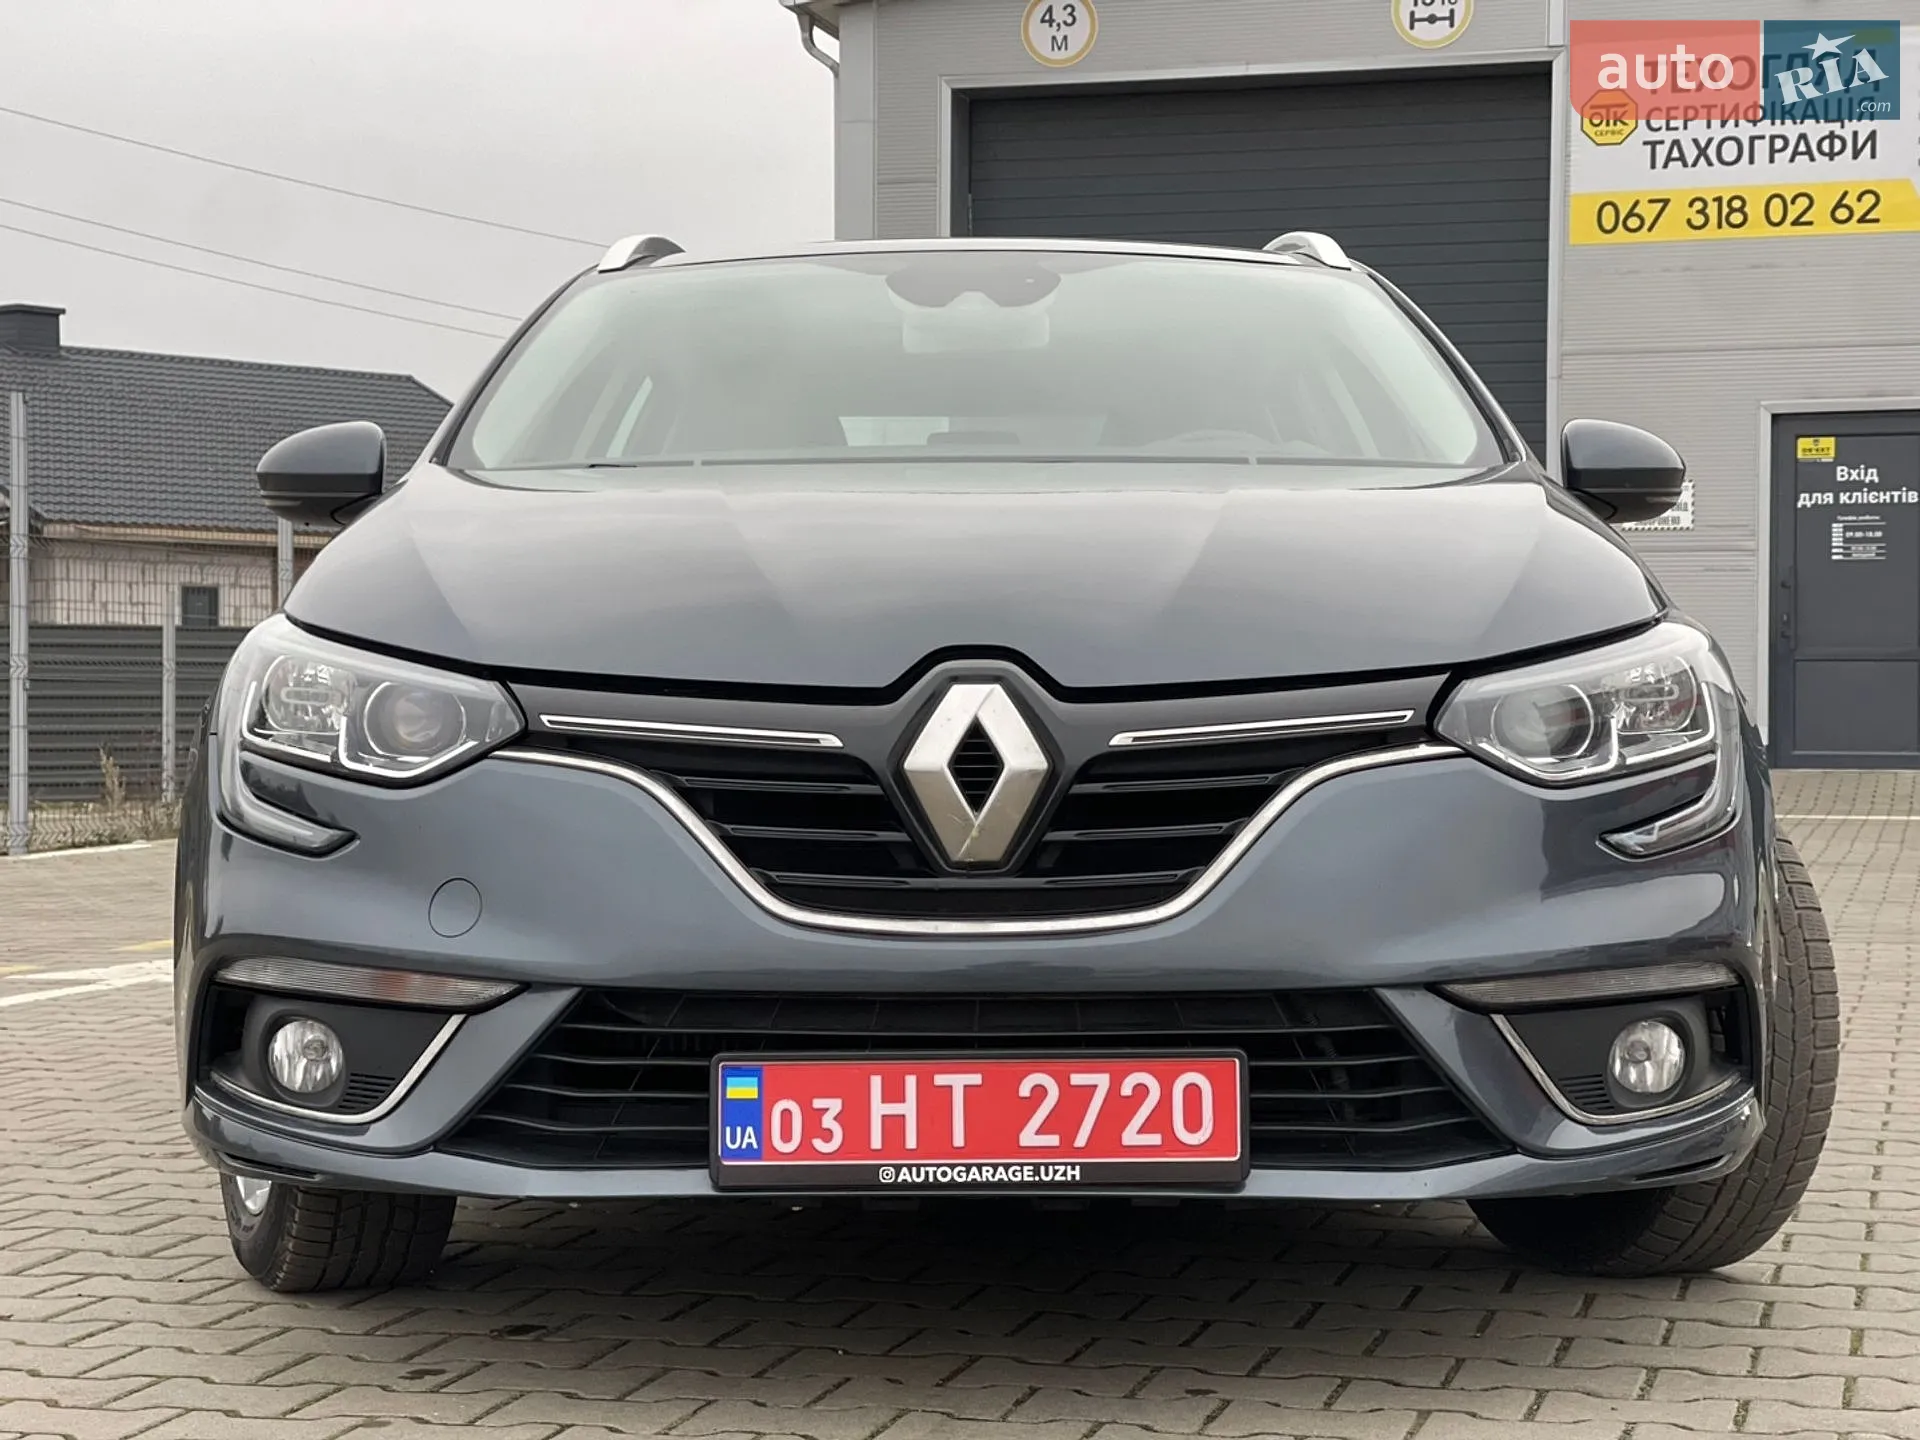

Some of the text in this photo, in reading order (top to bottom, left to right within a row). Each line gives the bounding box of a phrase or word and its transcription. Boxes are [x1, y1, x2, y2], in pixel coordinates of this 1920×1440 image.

[1040, 3, 1077, 32] 4,3
[1645, 96, 1875, 132] СЕРТИФІКАЦІЯ
[1642, 129, 1878, 170] ТАХОГРАФИ
[1596, 189, 1881, 235] 067 318 02 62
[1836, 465, 1879, 483] Вхід
[1797, 487, 1918, 508] для клієнтів
[770, 1071, 1214, 1154] 03 HT 2720
[725, 1126, 758, 1150] UA
[898, 1165, 1081, 1183] AUTOGARAGE.UZH
